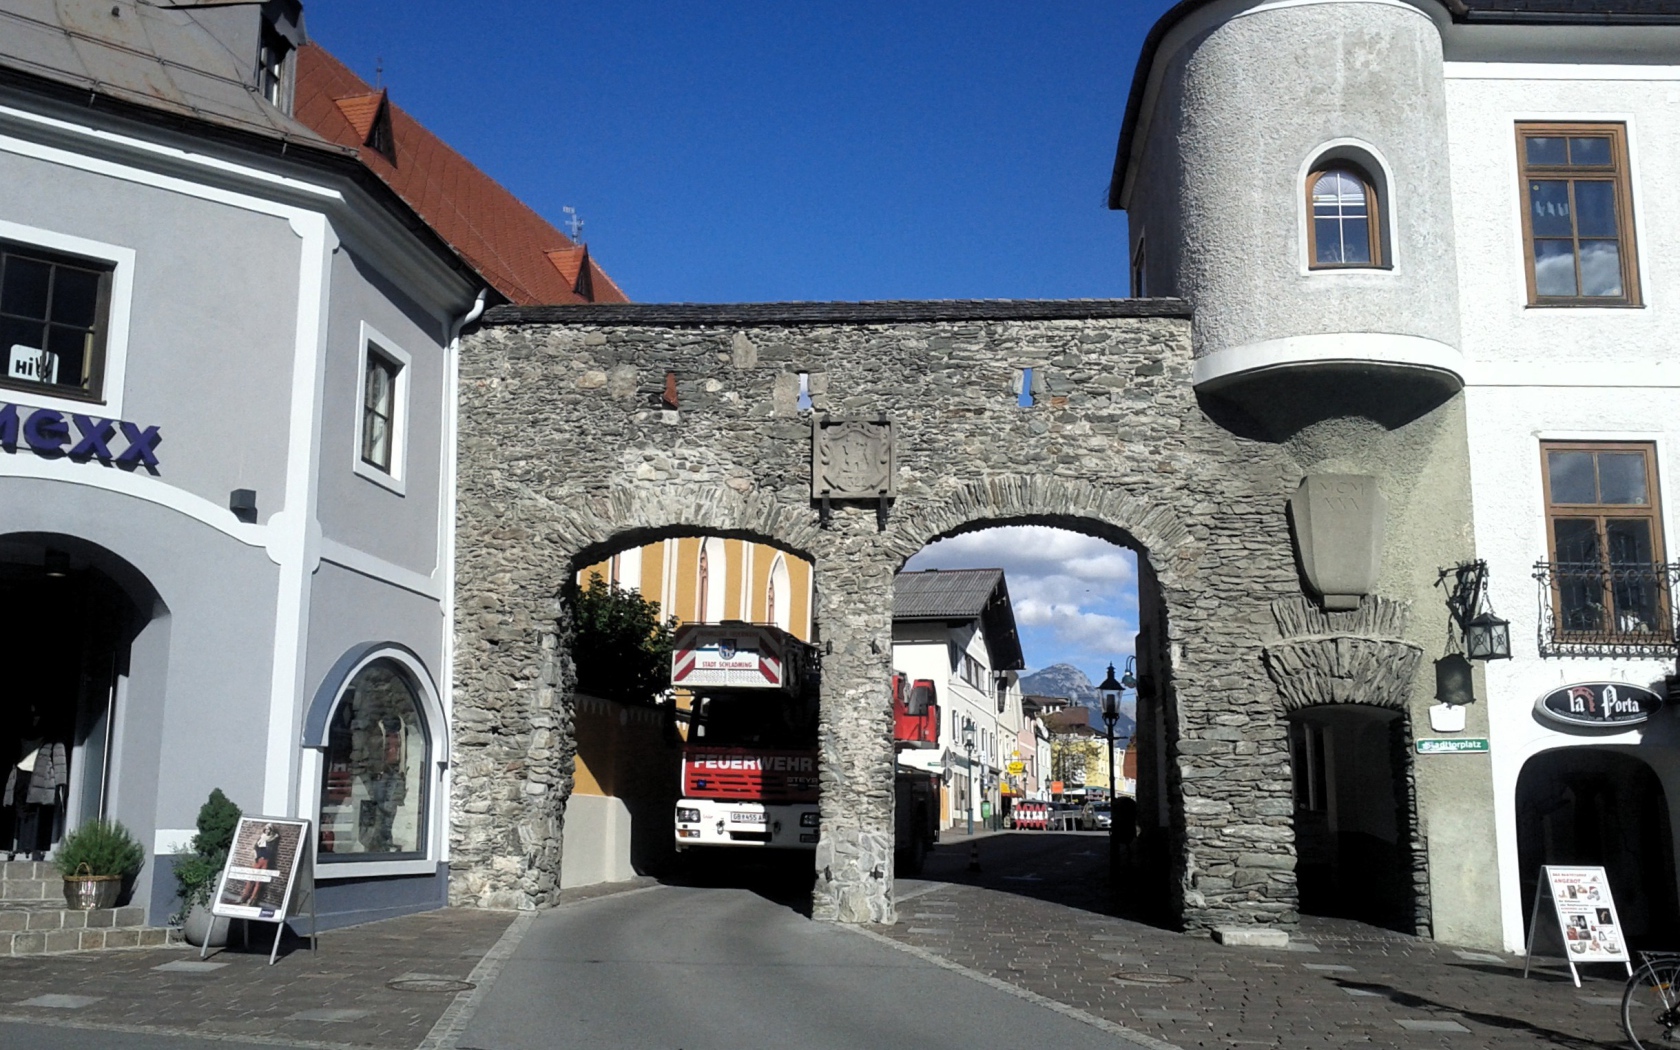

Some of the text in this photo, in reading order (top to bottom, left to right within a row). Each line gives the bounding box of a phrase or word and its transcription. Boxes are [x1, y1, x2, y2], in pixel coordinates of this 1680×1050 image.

[15, 357, 33, 376] Hi
[1601, 685, 1640, 719] Porta
[694, 754, 813, 772] FEUERWEHR
[787, 776, 818, 784] STEYR
